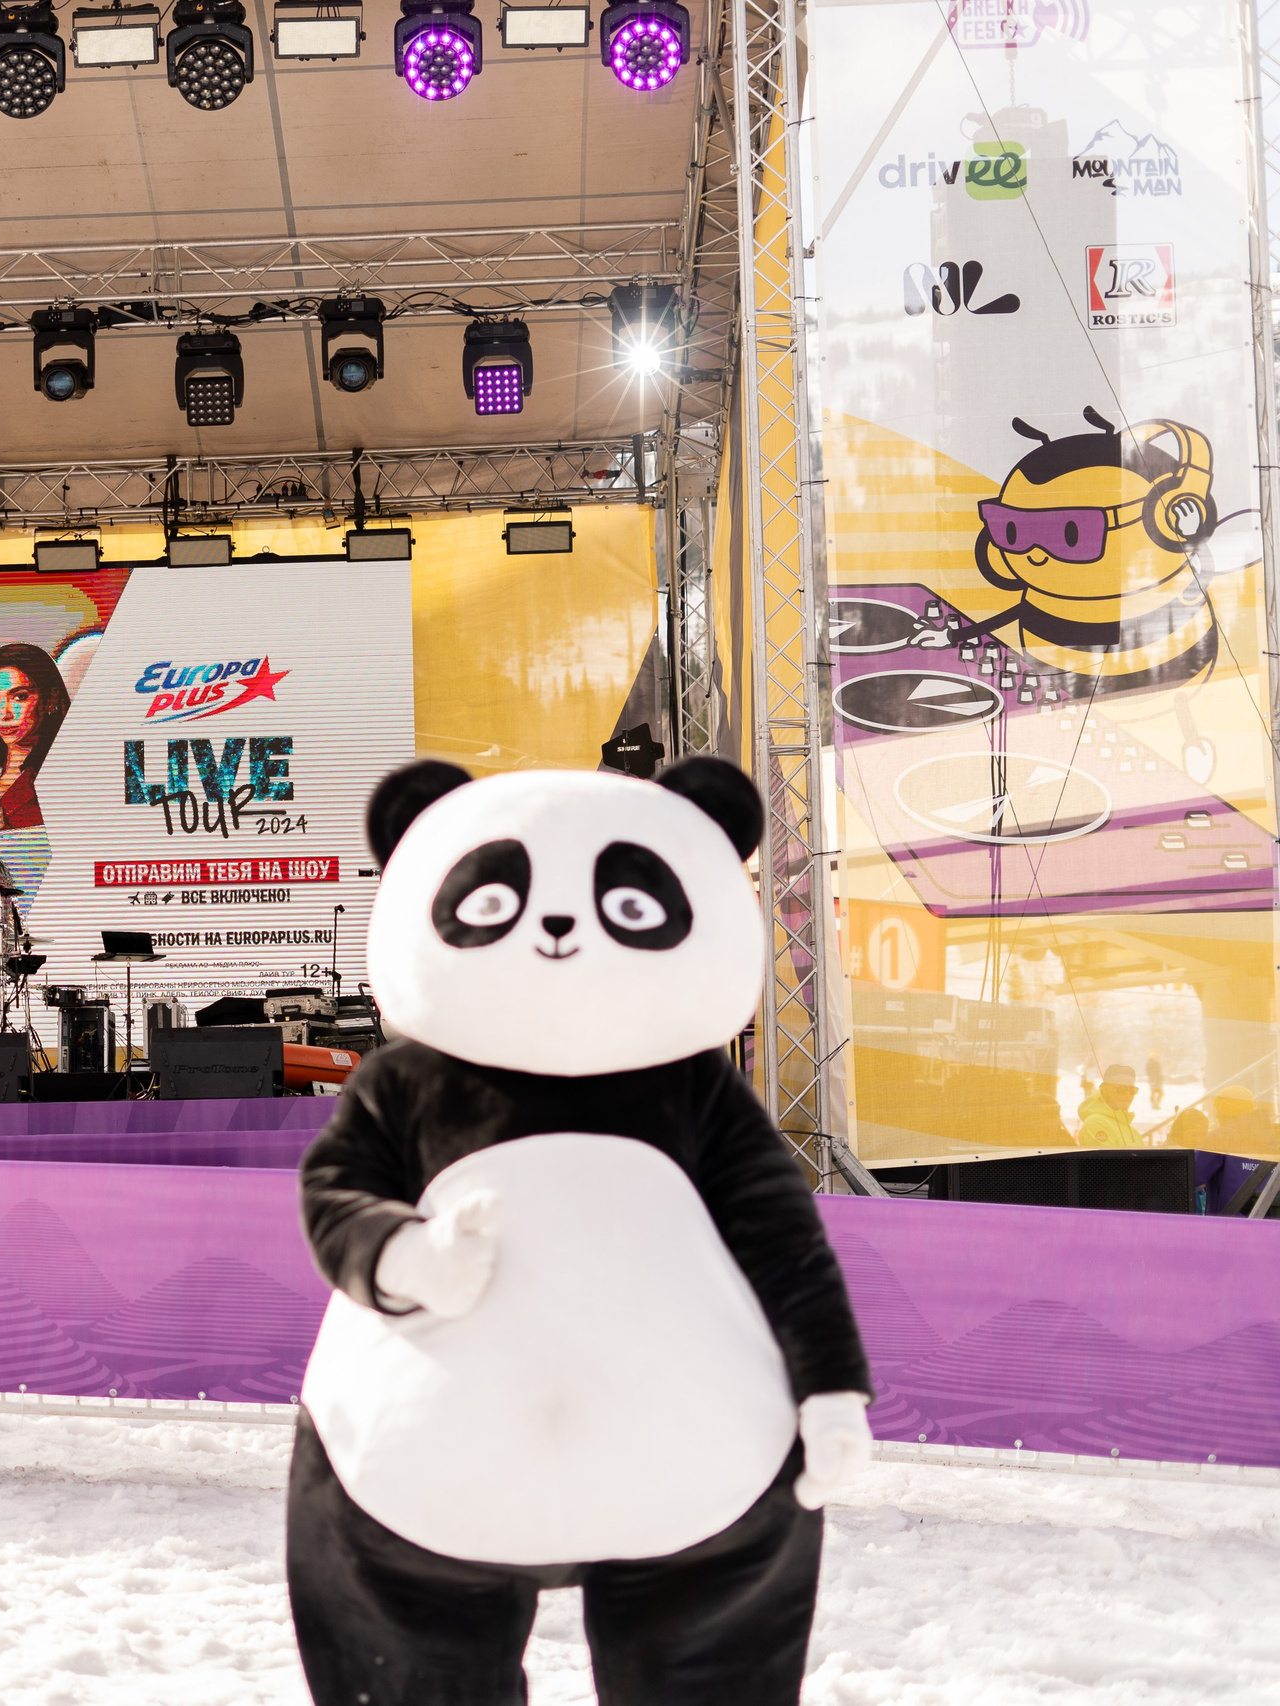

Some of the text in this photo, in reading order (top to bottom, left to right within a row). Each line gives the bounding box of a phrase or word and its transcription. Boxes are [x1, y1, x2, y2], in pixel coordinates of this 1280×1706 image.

[963, 20, 1006, 40] FEST
[878, 152, 1027, 189] drivee
[1072, 158, 1179, 178] MOUNTAIN
[1133, 178, 1182, 196] MAN
[1092, 312, 1172, 326] ROSTIC'S
[124, 737, 294, 804] LIVE
[150, 784, 287, 838] TOUR
[255, 814, 308, 835] 2024
[103, 860, 331, 884] ОТПРАВИМ ТЕБЯ НА ШОУ
[181, 888, 291, 904] ВСЕ ВКЛЮЧЕНО!
[150, 929, 332, 947] БНОСТИ НА EUROPAPLUS.RU
[300, 964, 331, 978] 12+
[173, 1064, 261, 1074] ProTone
